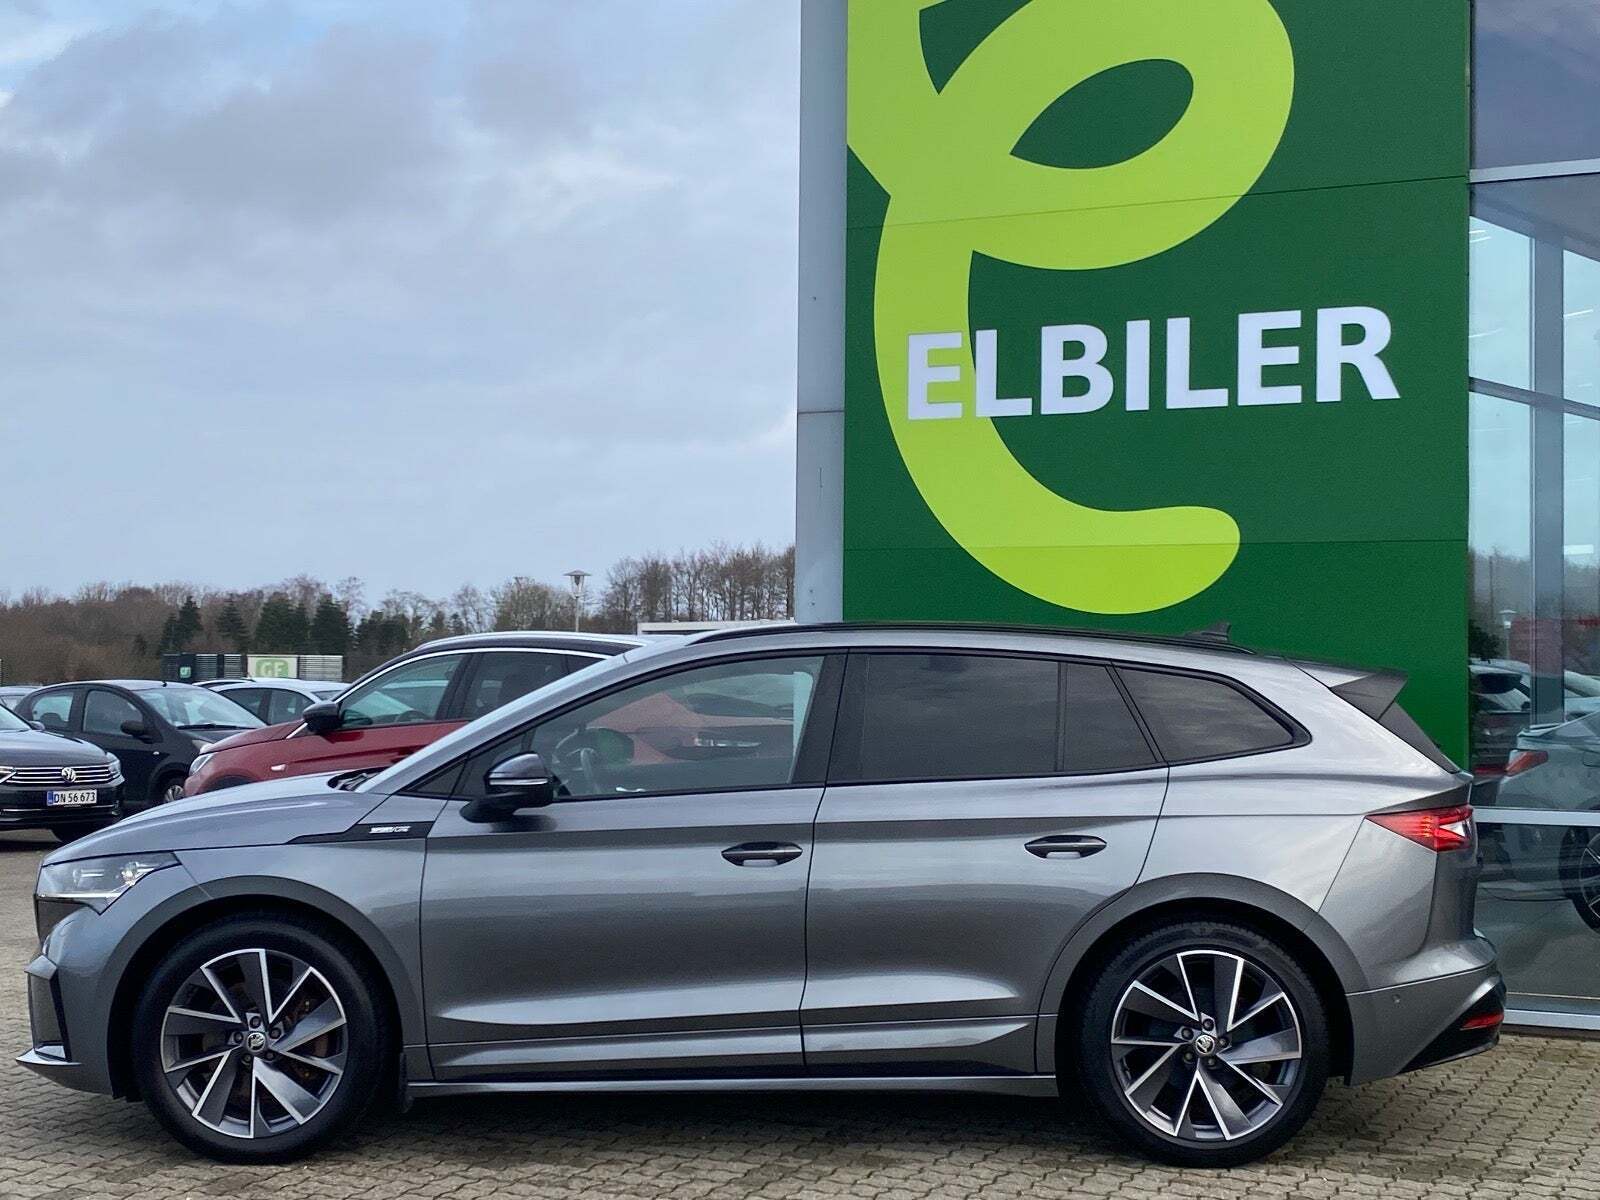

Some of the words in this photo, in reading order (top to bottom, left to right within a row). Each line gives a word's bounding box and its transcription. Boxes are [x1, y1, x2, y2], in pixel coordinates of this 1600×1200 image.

[907, 306, 1400, 420] ELBILER
[68, 793, 78, 802] 56
[80, 792, 96, 801] 673
